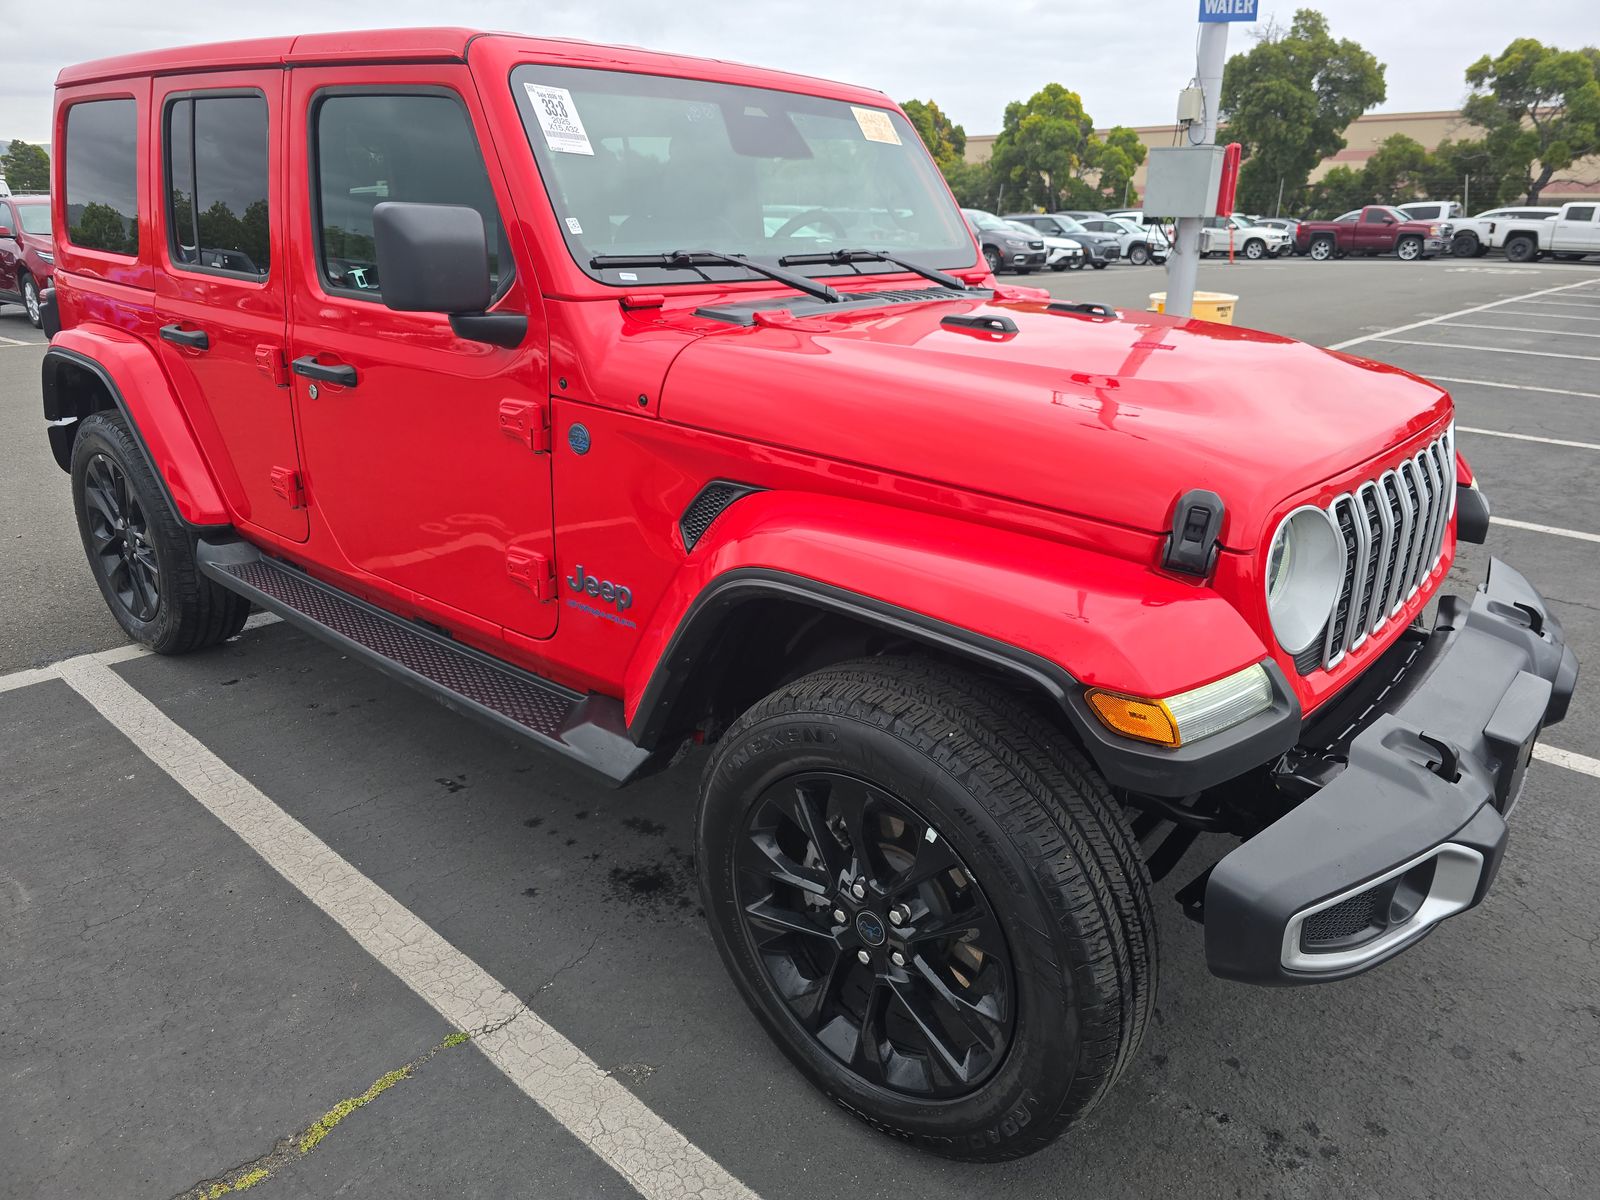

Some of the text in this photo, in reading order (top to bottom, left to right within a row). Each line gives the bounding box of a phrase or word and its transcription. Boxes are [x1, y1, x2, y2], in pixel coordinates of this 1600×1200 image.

[1204, 0, 1255, 14] WATER
[541, 98, 568, 118] 33:8
[551, 117, 571, 126] 2025
[566, 563, 633, 613] Jeep
